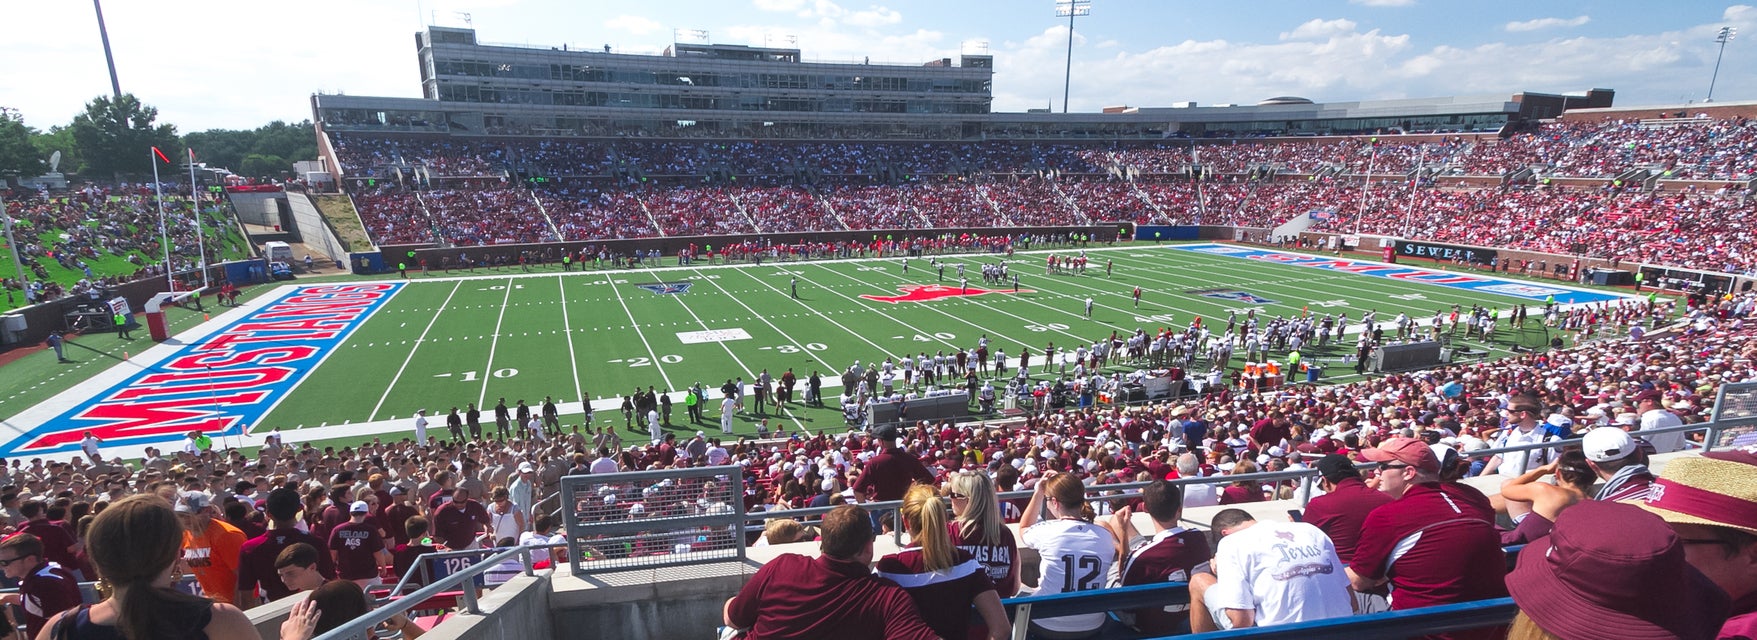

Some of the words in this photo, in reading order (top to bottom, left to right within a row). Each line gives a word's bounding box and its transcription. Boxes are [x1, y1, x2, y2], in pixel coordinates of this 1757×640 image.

[1024, 322, 1071, 332] 50
[912, 332, 957, 342] 40
[772, 342, 829, 353] 30
[9, 282, 397, 454] MUSTANGS
[626, 354, 684, 368] 20
[459, 367, 519, 382] 10
[339, 530, 369, 539] RELOAD
[344, 538, 361, 546] AGS
[956, 545, 989, 562] XAS
[1271, 541, 1322, 567] Texas
[443, 556, 472, 576] 126
[1061, 554, 1103, 593] 12
